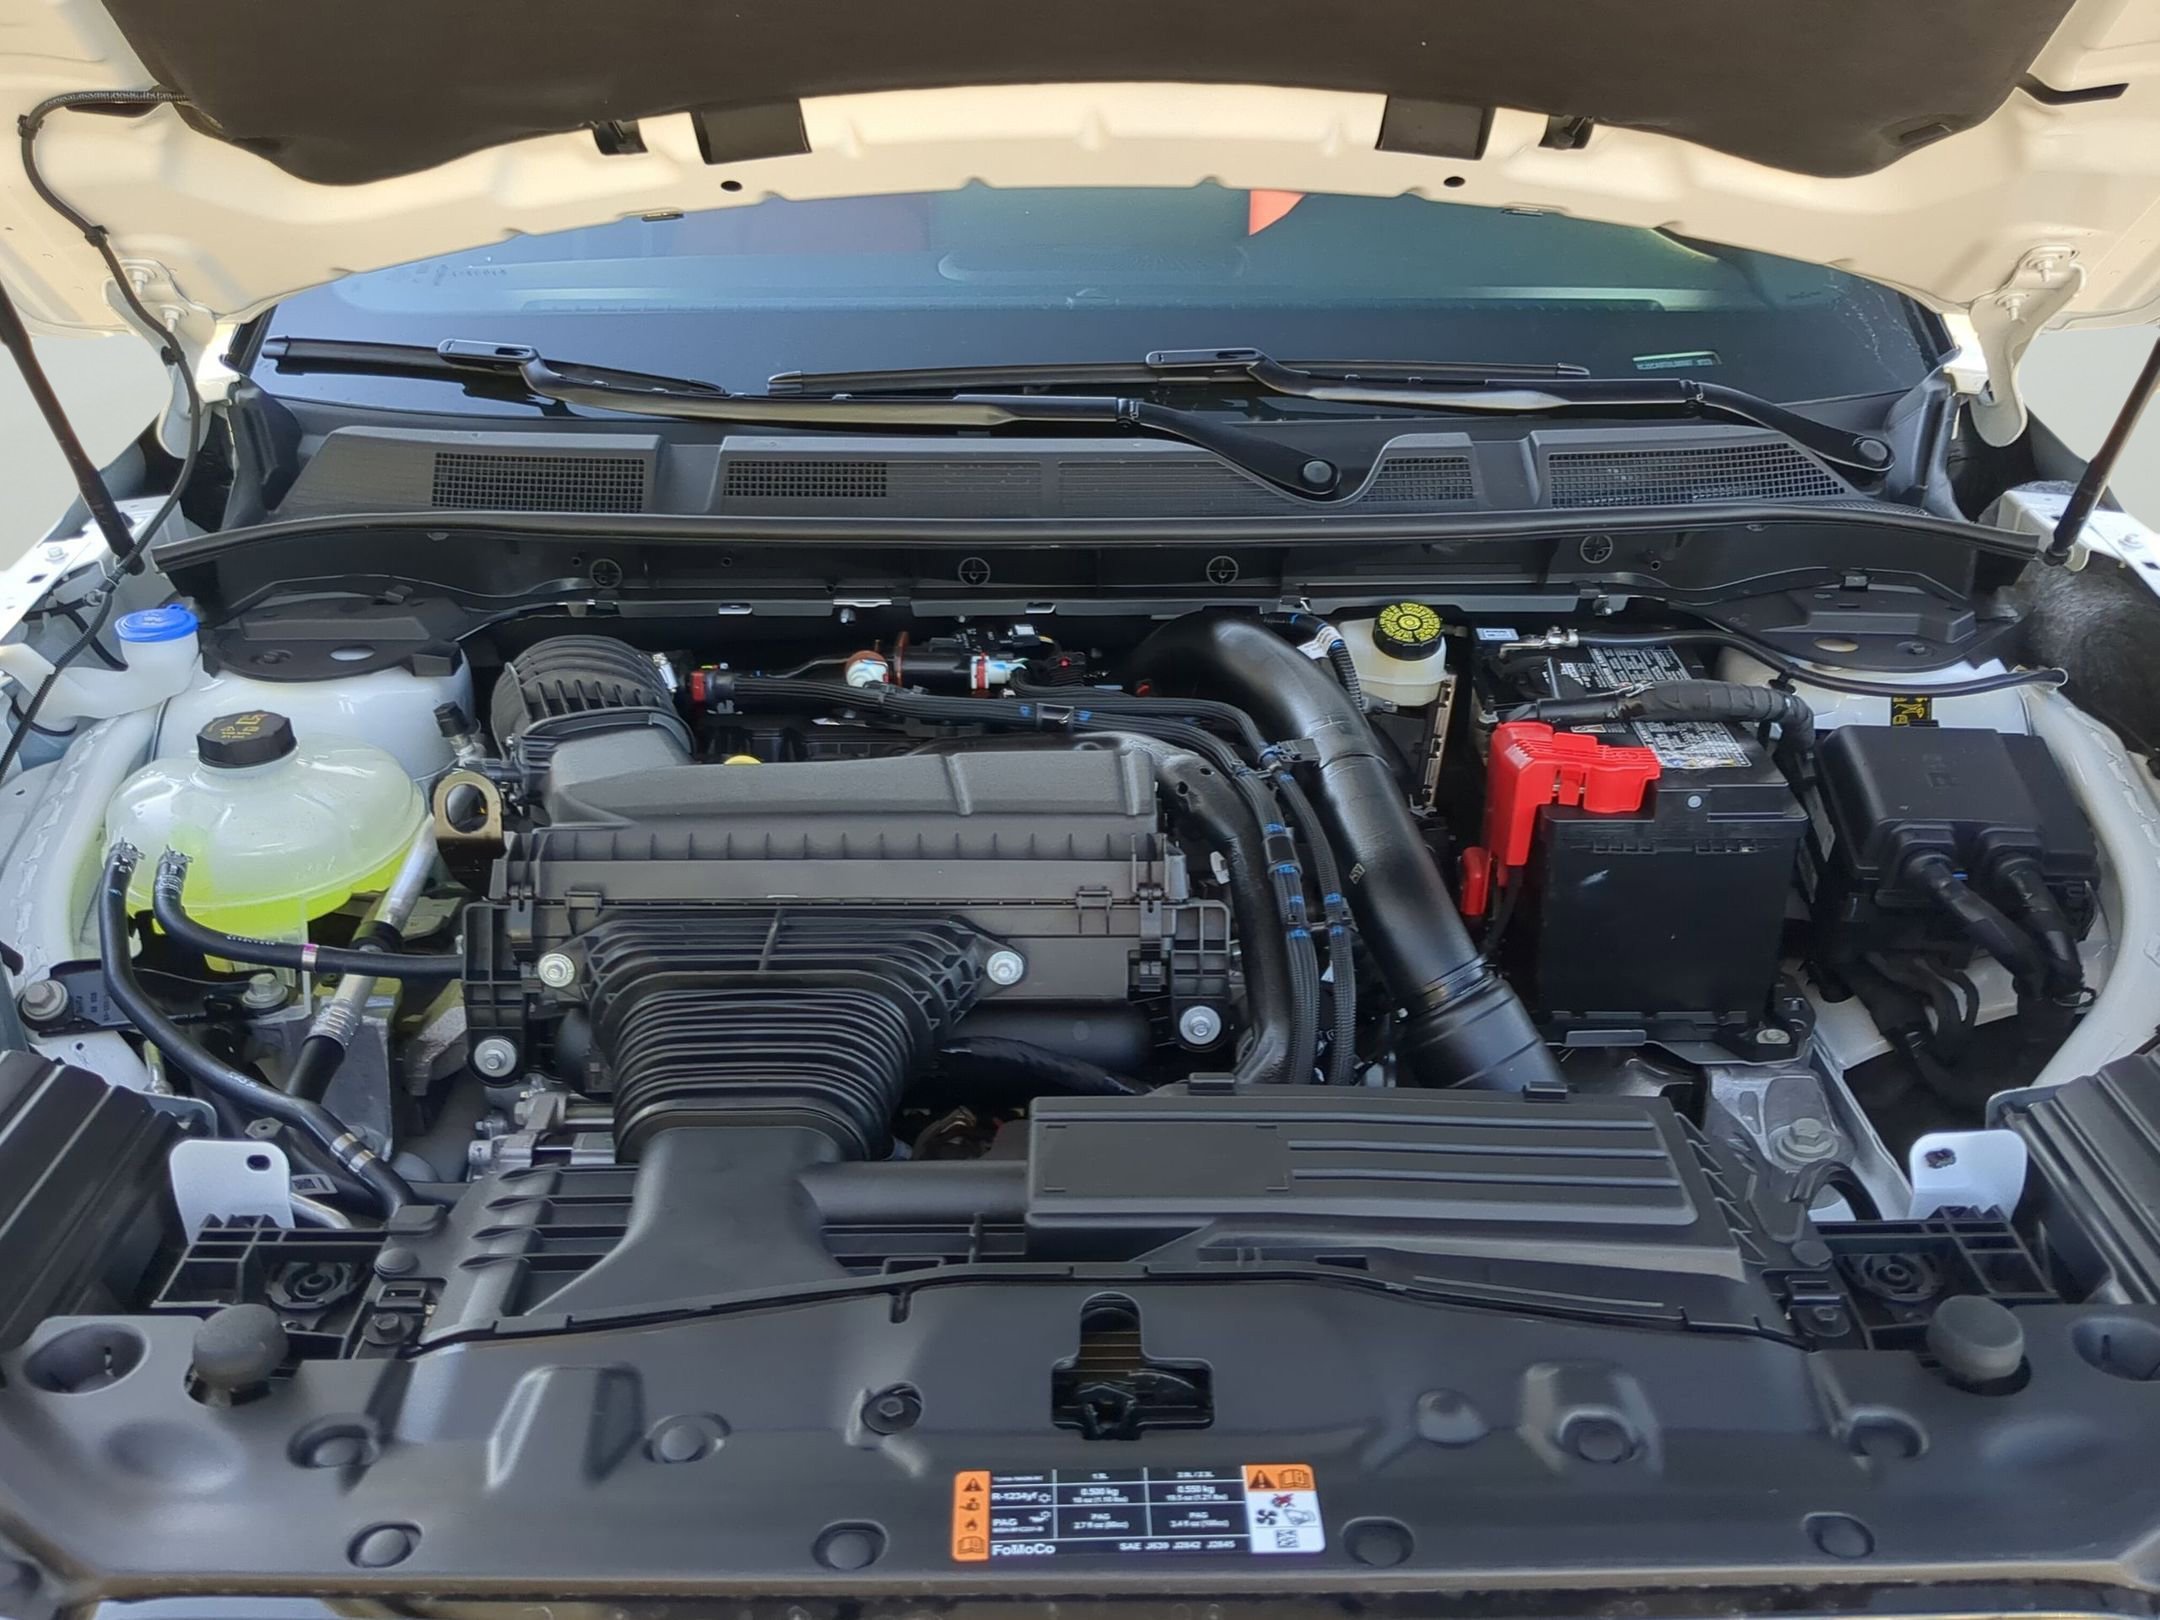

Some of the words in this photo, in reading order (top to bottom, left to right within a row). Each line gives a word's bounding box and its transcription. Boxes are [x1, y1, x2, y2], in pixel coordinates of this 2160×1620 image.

[992, 1518, 1018, 1527] PAG
[991, 1542, 1056, 1556] FoMoCo
[1119, 1542, 1142, 1551] SAE
